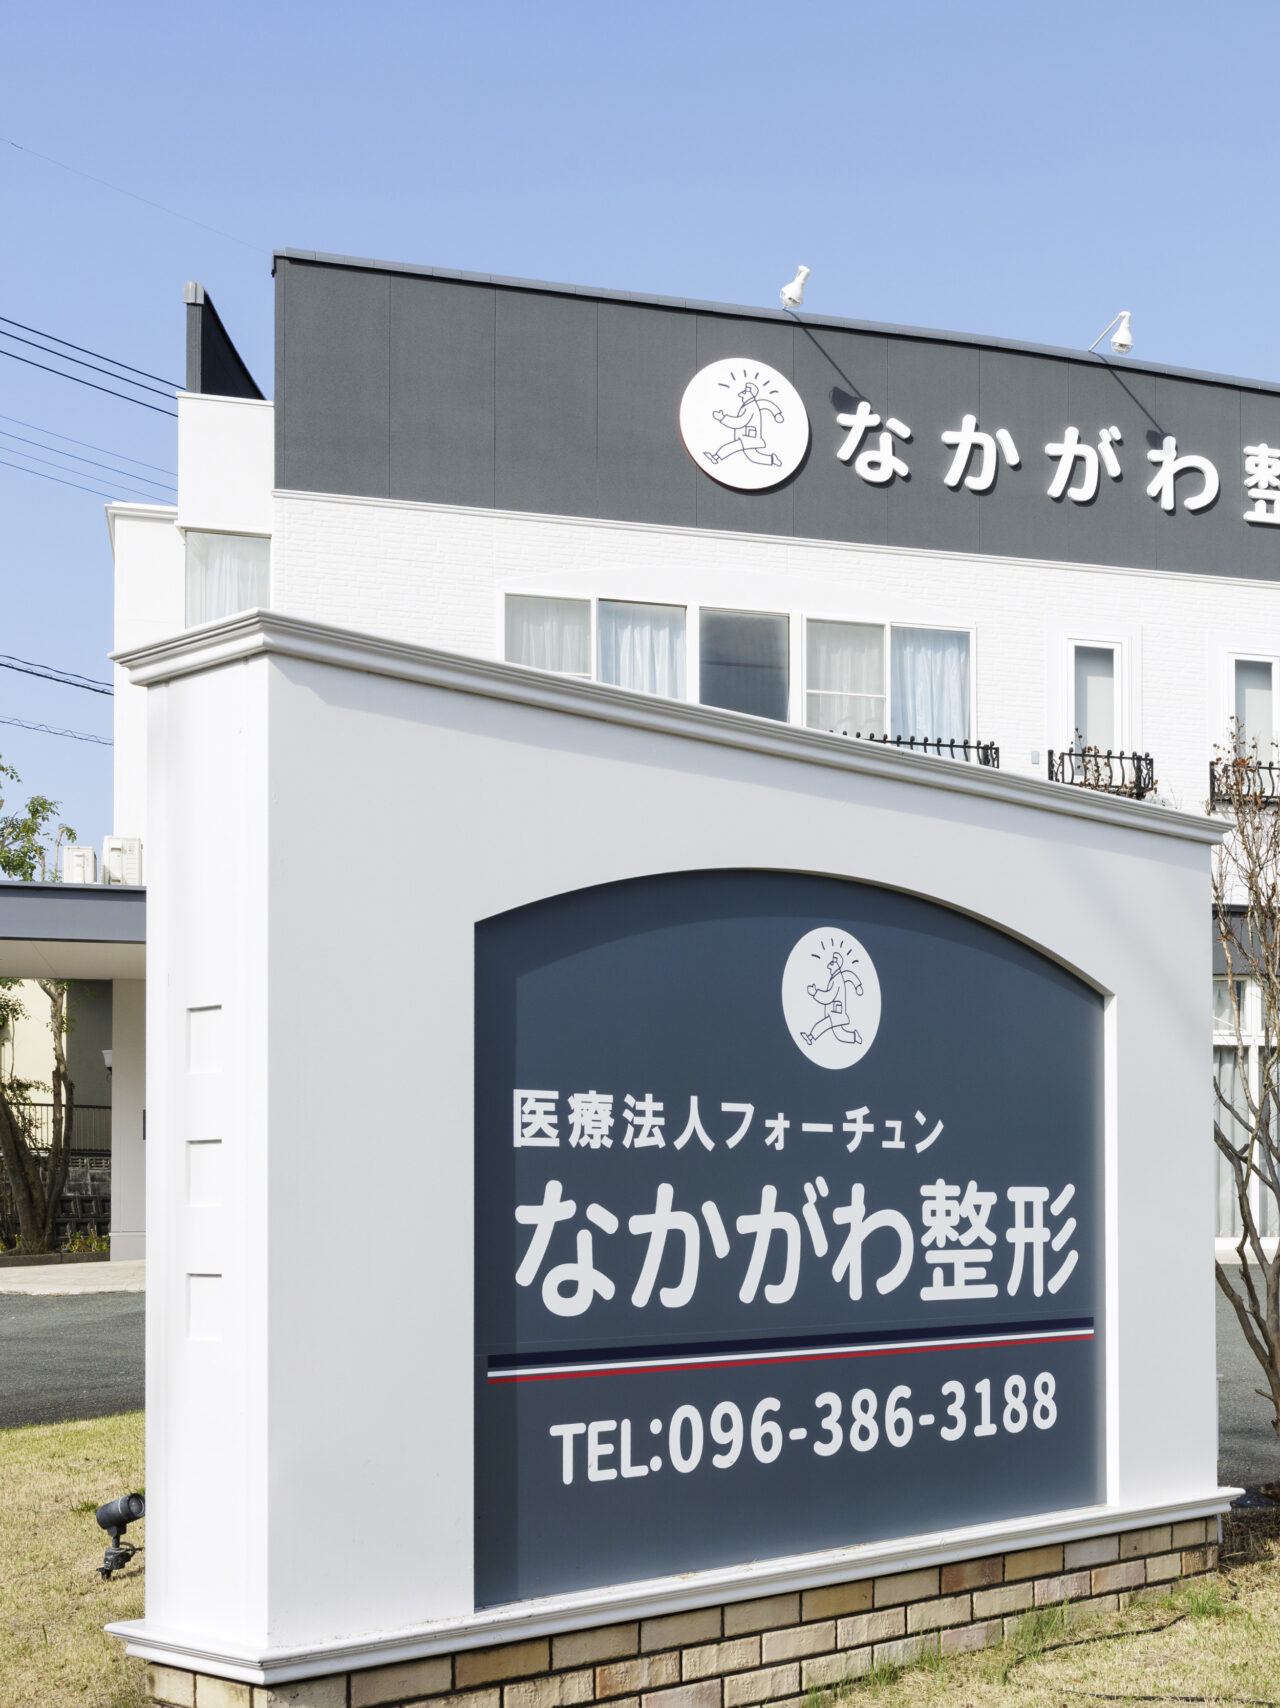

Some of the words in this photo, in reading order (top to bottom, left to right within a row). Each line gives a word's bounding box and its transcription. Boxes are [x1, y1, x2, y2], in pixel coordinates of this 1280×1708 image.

[513, 1088, 944, 1154] 医療法人フォーチュン
[515, 1176, 1079, 1317] なかがわ整形
[549, 1371, 1058, 1485] TEL:096-386-3188
